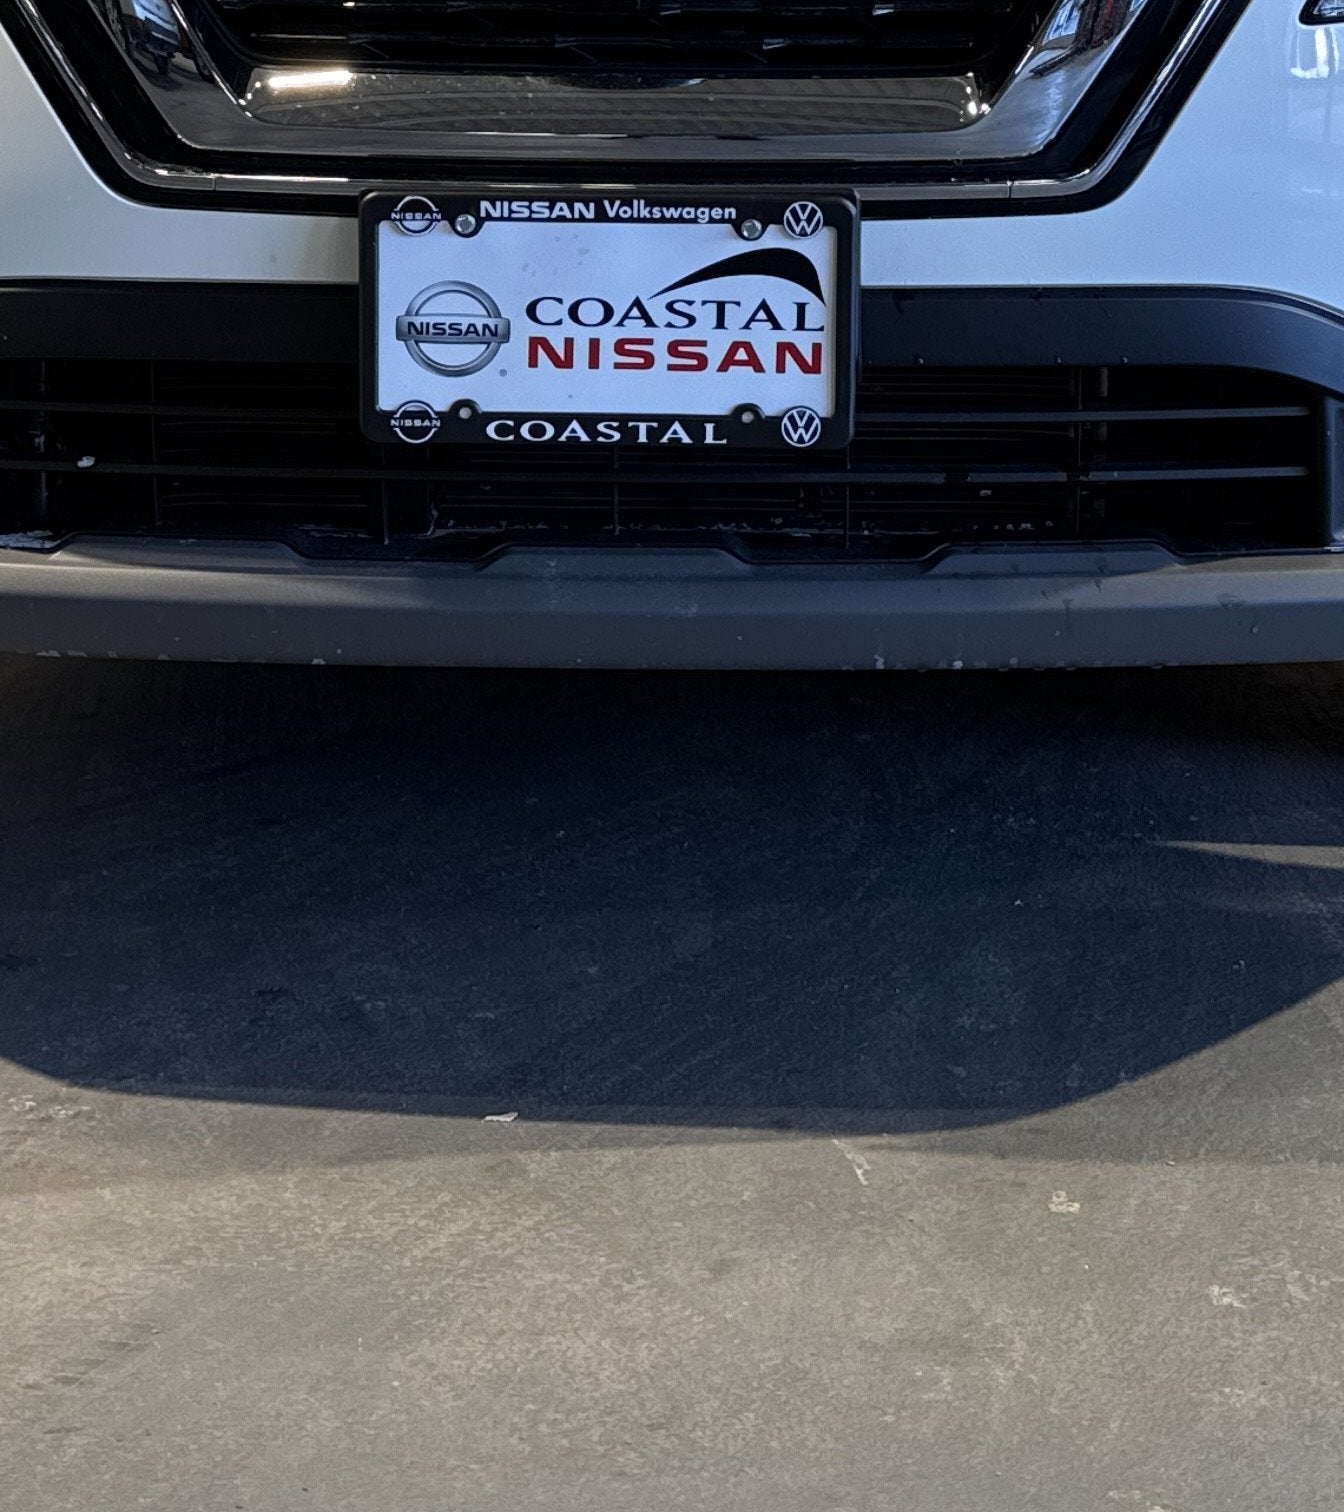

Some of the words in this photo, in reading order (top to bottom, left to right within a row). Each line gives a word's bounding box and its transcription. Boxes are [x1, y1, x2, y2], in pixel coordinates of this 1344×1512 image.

[391, 211, 442, 221] NISSAN
[479, 200, 595, 220] NISSAN
[604, 199, 737, 222] Volkswagen
[525, 296, 824, 331] COASTAL
[406, 321, 499, 339] NISSAN
[528, 336, 822, 375] NISSAN
[390, 419, 441, 428] NISSAN
[486, 419, 727, 445] COASTAL
